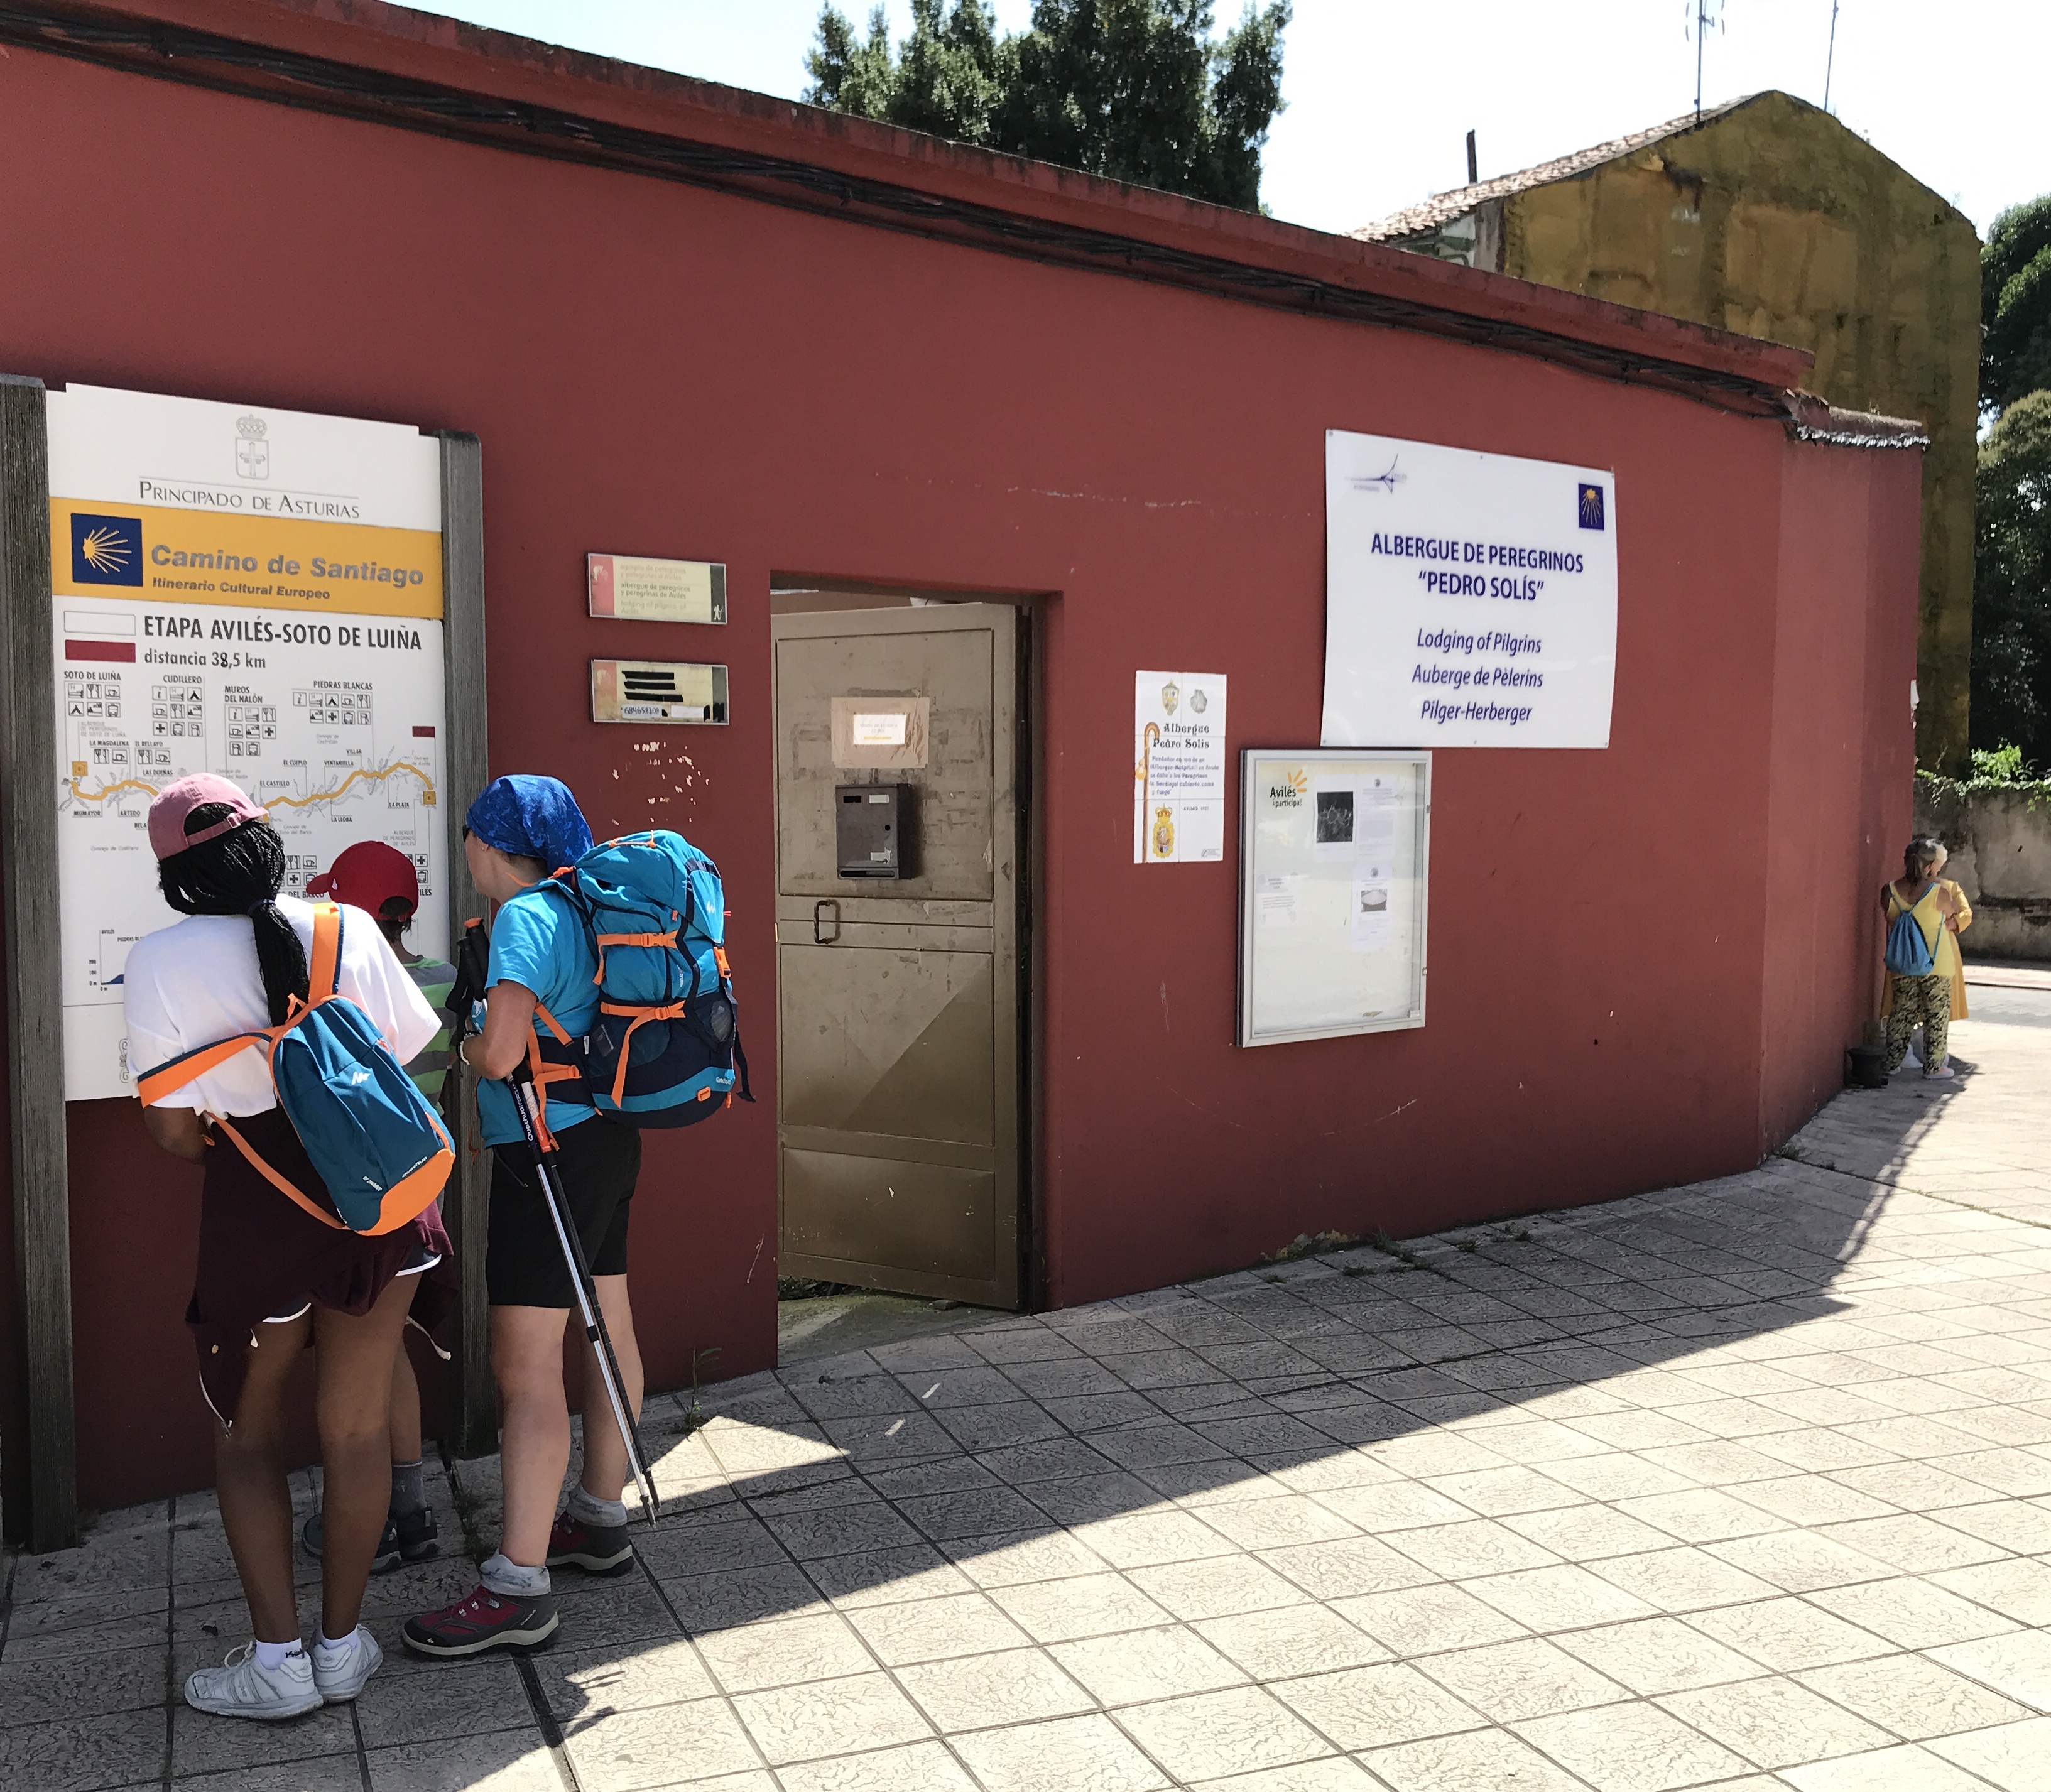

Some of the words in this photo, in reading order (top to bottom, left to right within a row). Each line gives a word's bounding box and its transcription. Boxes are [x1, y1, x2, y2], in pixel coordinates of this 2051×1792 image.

[253, 496, 272, 511] DE
[1371, 533, 1459, 561] ALBERGUE
[1464, 543, 1485, 564] DE
[1489, 545, 1584, 573] PEREGRINOS
[151, 544, 258, 572] Camino
[268, 554, 301, 575] de
[310, 557, 424, 589] Santiago
[153, 577, 215, 592] Itinerario
[220, 582, 273, 595] Cultural
[277, 585, 330, 600] Europeo
[621, 582, 648, 590] albergue
[626, 590, 658, 598] peregrinas
[144, 615, 203, 638] ETAPA
[210, 616, 332, 645] AVILÉS-SOTO
[338, 626, 361, 646] DE
[368, 624, 422, 649] LUIÑA
[1417, 627, 1473, 654] Lodging
[1477, 631, 1493, 650] of
[1493, 632, 1542, 657] Pilgrins
[144, 648, 207, 666] distancia
[212, 651, 241, 670] 38,5
[246, 653, 266, 668] km
[64, 671, 84, 680] SOTO
[87, 671, 95, 680] DE
[99, 670, 121, 681] LUIÑA
[163, 675, 202, 683] CUDILLERO
[1412, 663, 1471, 690] Auberge
[1473, 666, 1489, 686] de
[1492, 667, 1543, 688] Pèlerins
[225, 685, 250, 693] MUROS
[313, 680, 341, 689] PIEDRAS
[343, 682, 373, 690] BLANCAS
[225, 695, 237, 703] DEL
[239, 693, 263, 703] NALÓN
[1421, 700, 1532, 726] Pilger-Herberger
[1164, 723, 1209, 736] Albergue
[1153, 738, 1181, 748] Pedro
[1270, 785, 1297, 798] Avilés
[520, 1107, 534, 1141] Quechua
